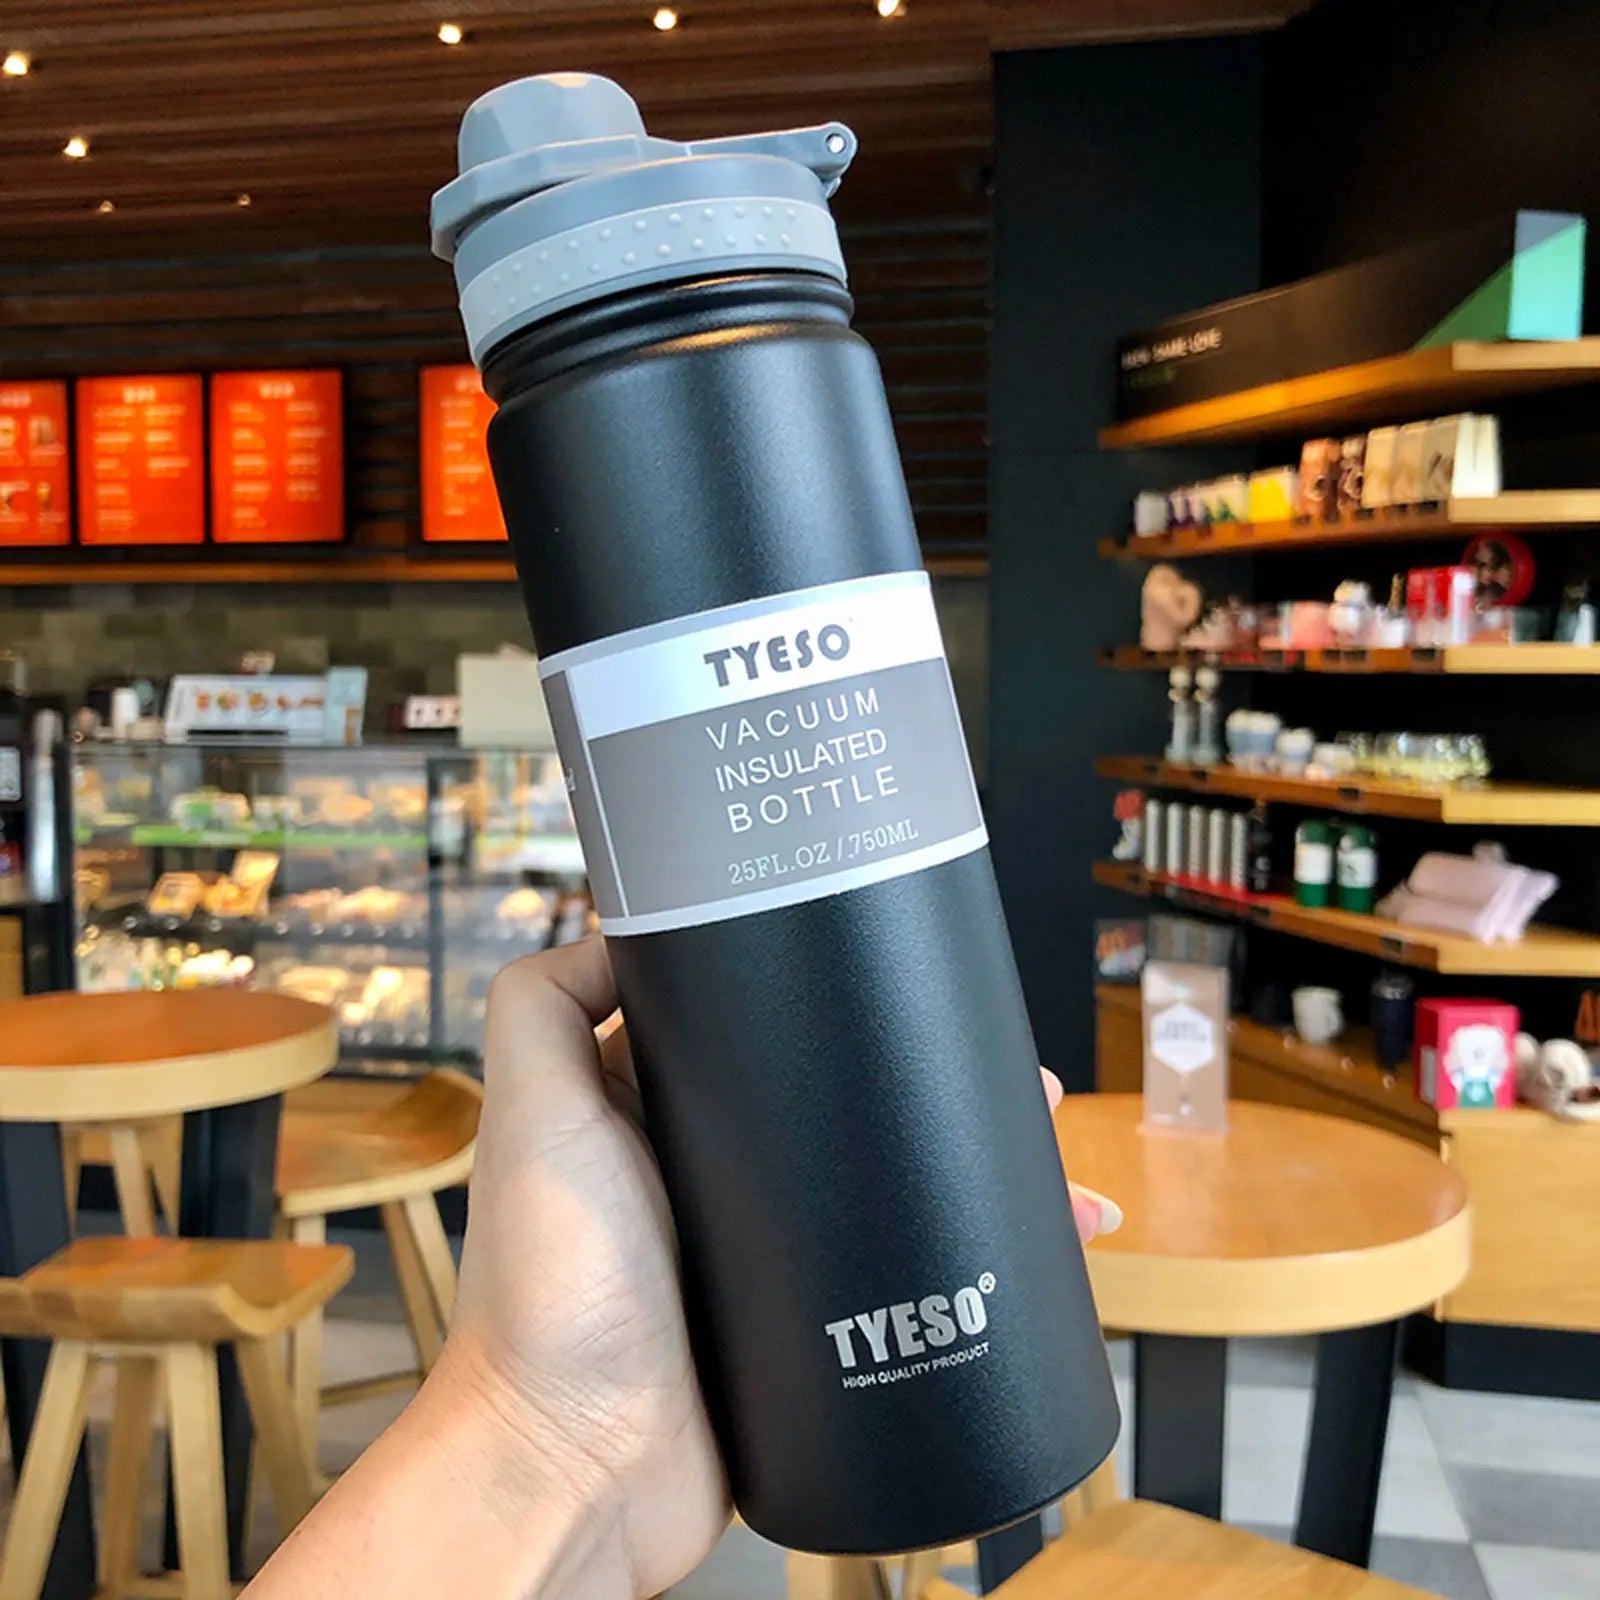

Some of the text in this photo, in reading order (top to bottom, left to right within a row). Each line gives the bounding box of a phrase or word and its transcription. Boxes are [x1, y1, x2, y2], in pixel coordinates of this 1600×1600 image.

[703, 624, 850, 687] TYESO
[705, 687, 880, 750] VACUUM
[715, 728, 887, 793] INSULATED
[726, 765, 899, 833] BOTTLE
[842, 1341, 990, 1390] HIGH QUALITY PRODUCT
